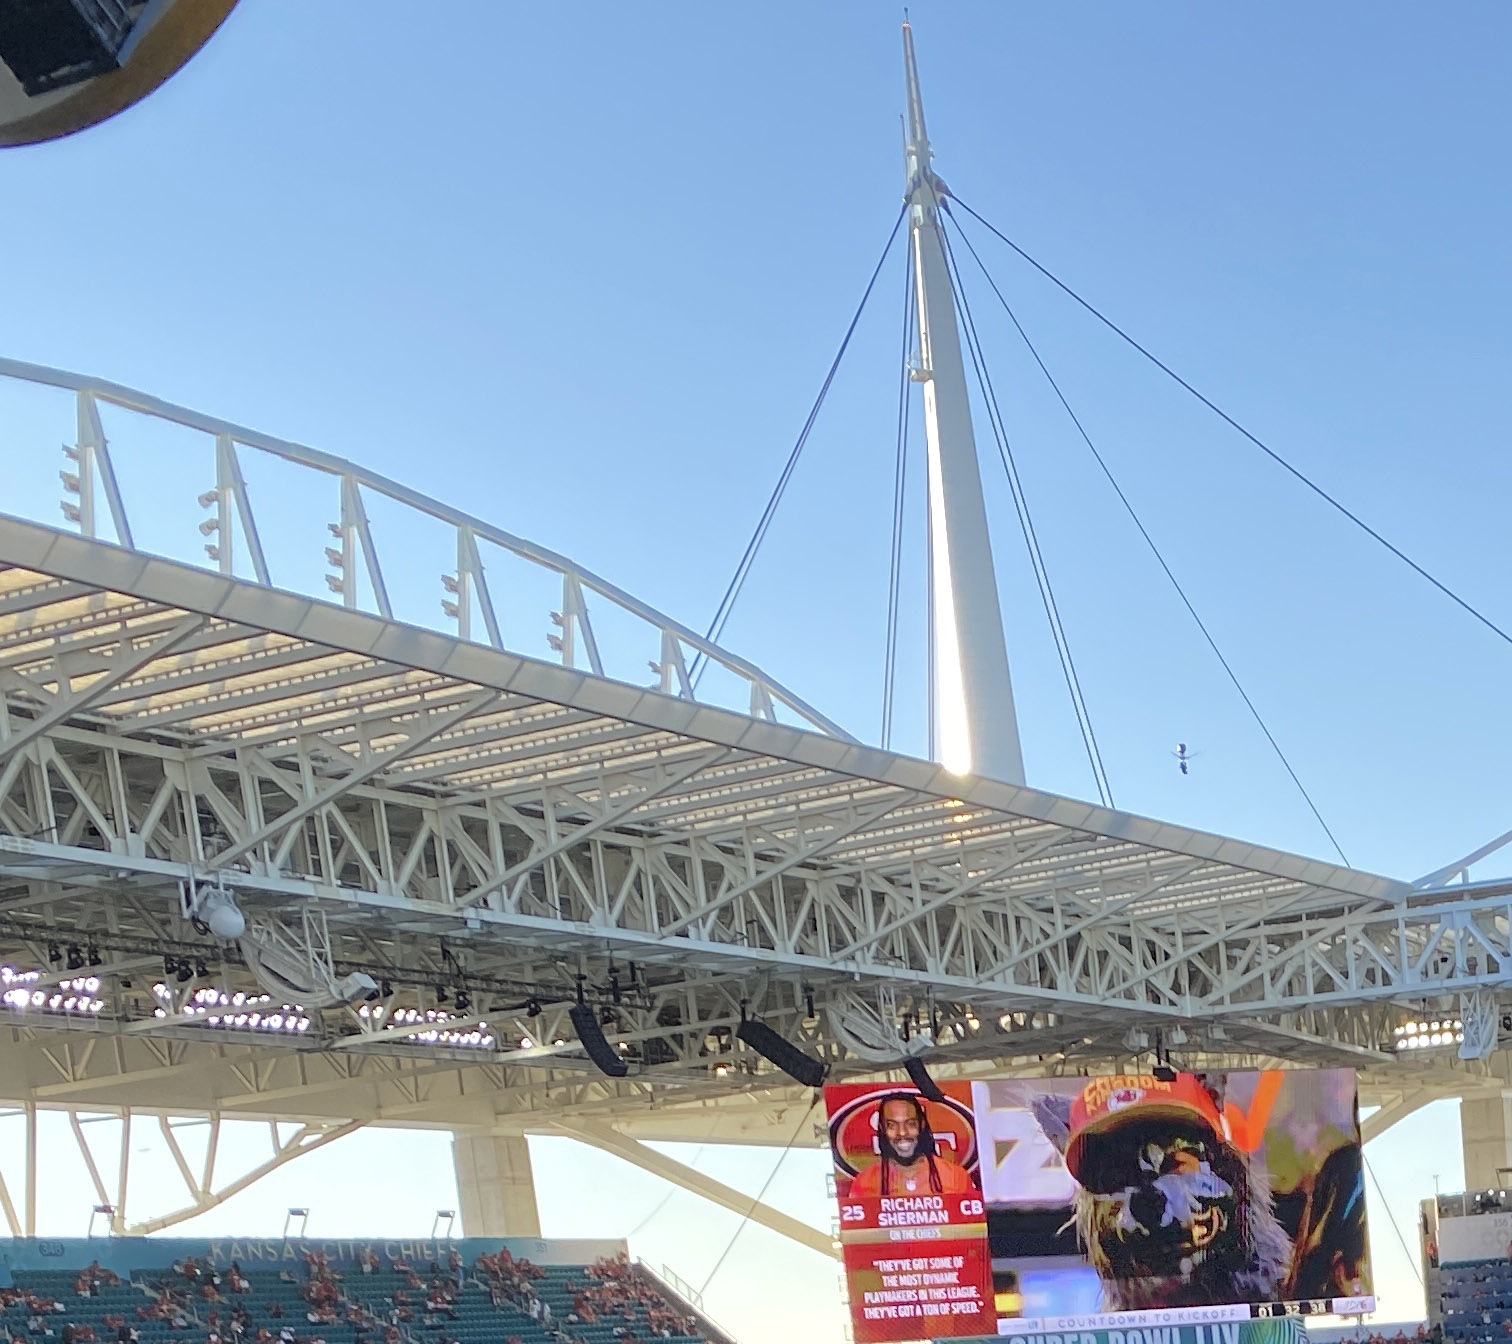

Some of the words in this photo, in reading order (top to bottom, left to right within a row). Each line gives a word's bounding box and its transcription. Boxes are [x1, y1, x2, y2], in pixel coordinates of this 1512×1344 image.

[880, 1196, 943, 1212] RICHARD
[960, 1200, 984, 1215] CB
[842, 1205, 865, 1221] 25
[878, 1210, 948, 1226] SHERMAN
[889, 1229, 901, 1240] ON
[901, 1229, 916, 1240] THE
[916, 1228, 942, 1239] CHIEFS
[912, 1259, 929, 1271] GOT
[929, 1257, 952, 1269] SOME
[952, 1256, 964, 1268] OF
[882, 1274, 899, 1287] THE
[899, 1273, 922, 1286] MOST
[923, 1272, 960, 1285] DYNAMIC
[864, 1290, 918, 1304] PLAYMAKERS
[918, 1289, 928, 1301] IN
[928, 1288, 947, 1300] THIS
[864, 1305, 898, 1320] THEY'VE
[898, 1305, 914, 1318] GOT
[922, 1303, 939, 1316] TON
[939, 1302, 951, 1315] OF
[1057, 1315, 1147, 1329] COUNTDOWN
[1154, 1313, 1171, 1323] TO
[1177, 1308, 1237, 1321] KICKOFF
